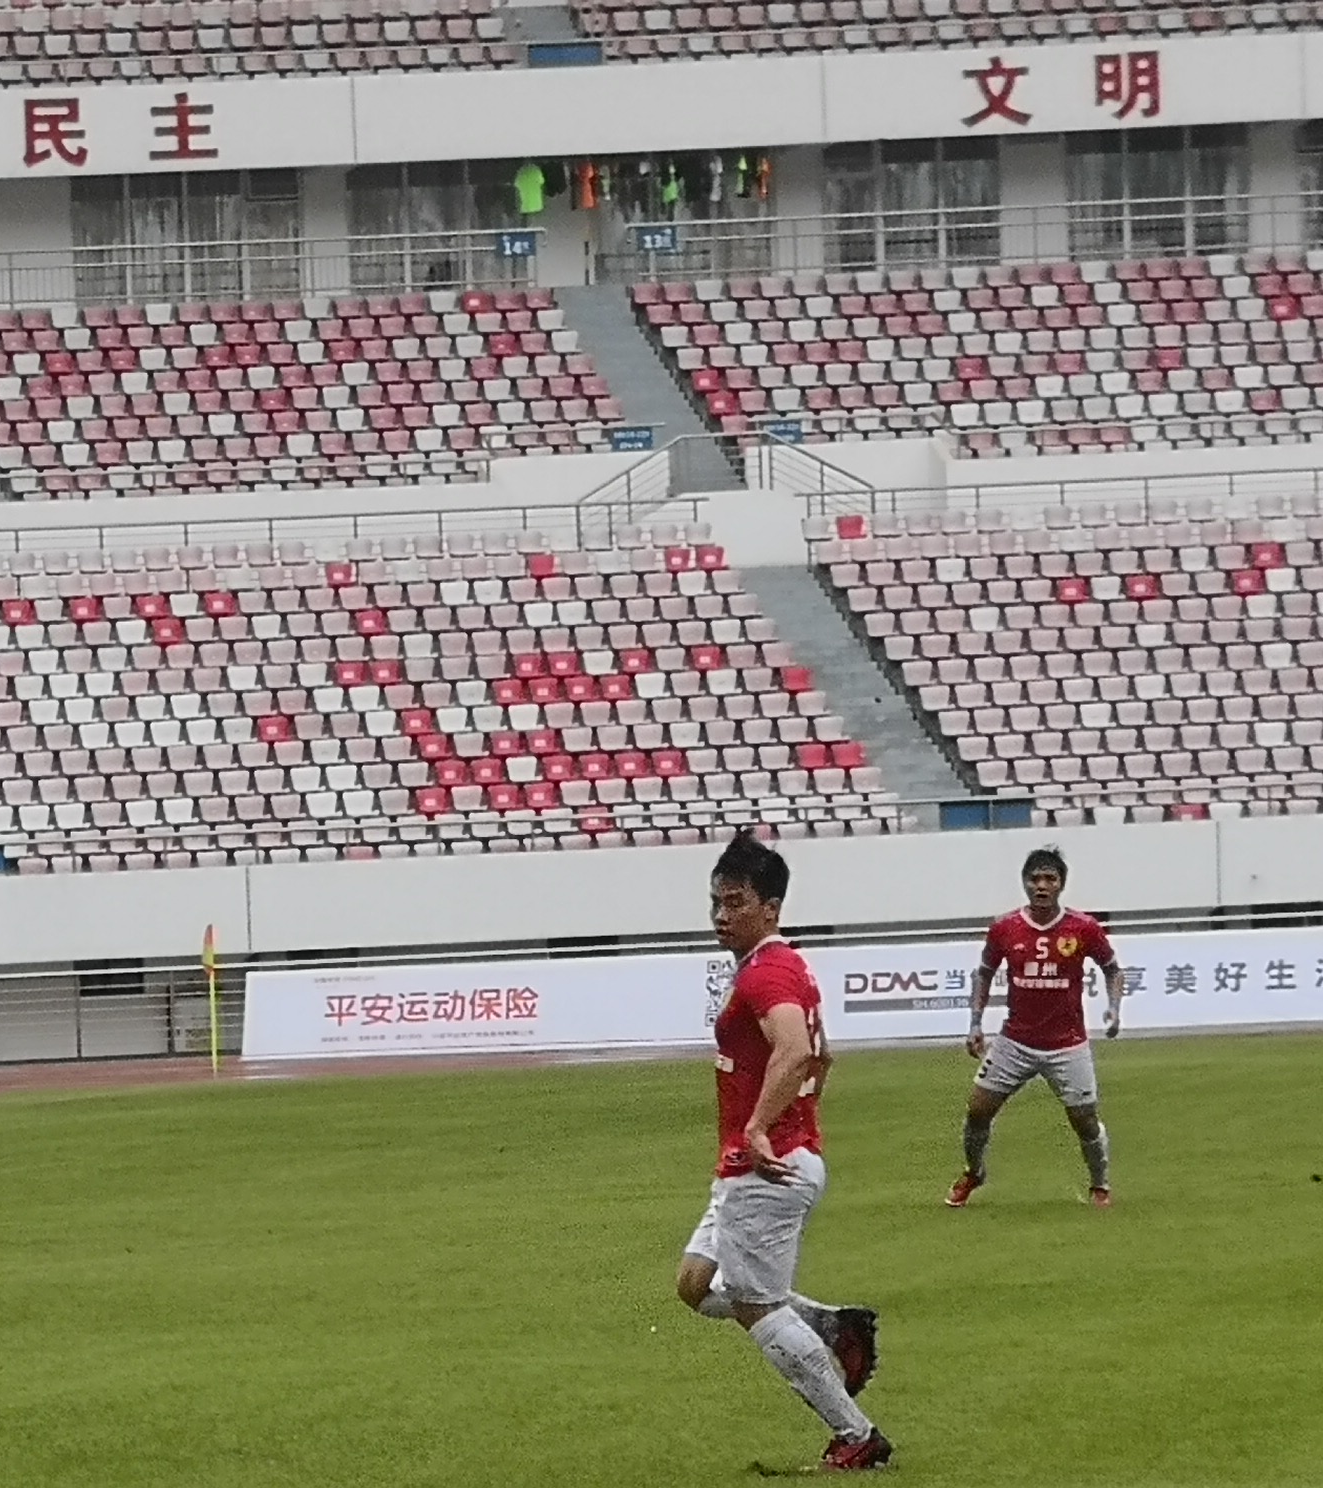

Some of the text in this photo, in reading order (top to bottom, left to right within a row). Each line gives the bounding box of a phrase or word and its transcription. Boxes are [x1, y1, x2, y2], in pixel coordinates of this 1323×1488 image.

[961, 50, 1161, 128] 文明
[22, 92, 219, 168] 民主
[323, 986, 539, 1027] 平安运动保险
[844, 970, 939, 995] DDMC
